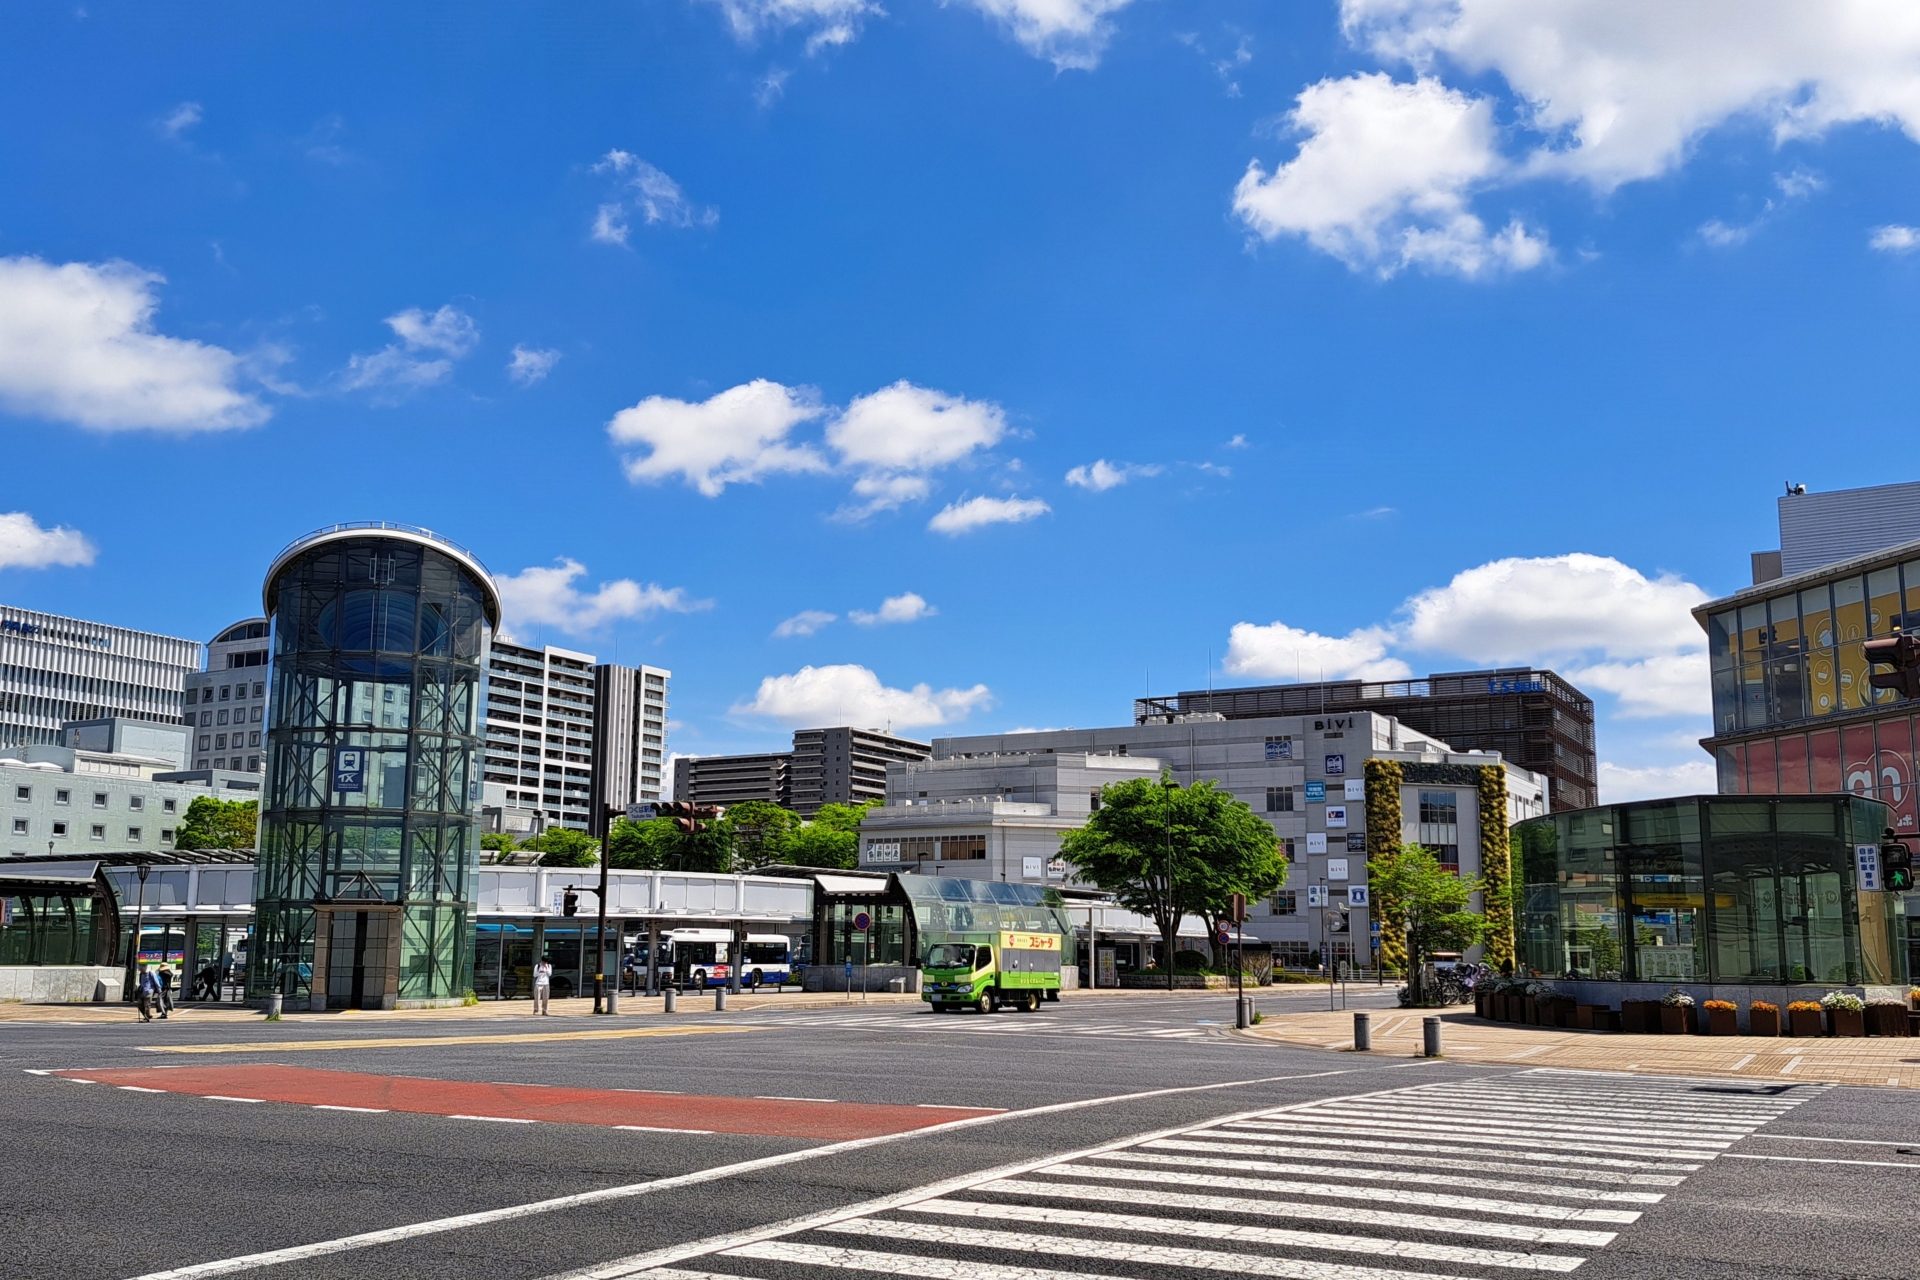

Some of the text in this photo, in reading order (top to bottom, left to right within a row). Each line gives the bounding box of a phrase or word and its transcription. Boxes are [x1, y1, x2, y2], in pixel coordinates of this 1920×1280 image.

[1029, 936, 1053, 948] スジャータ
